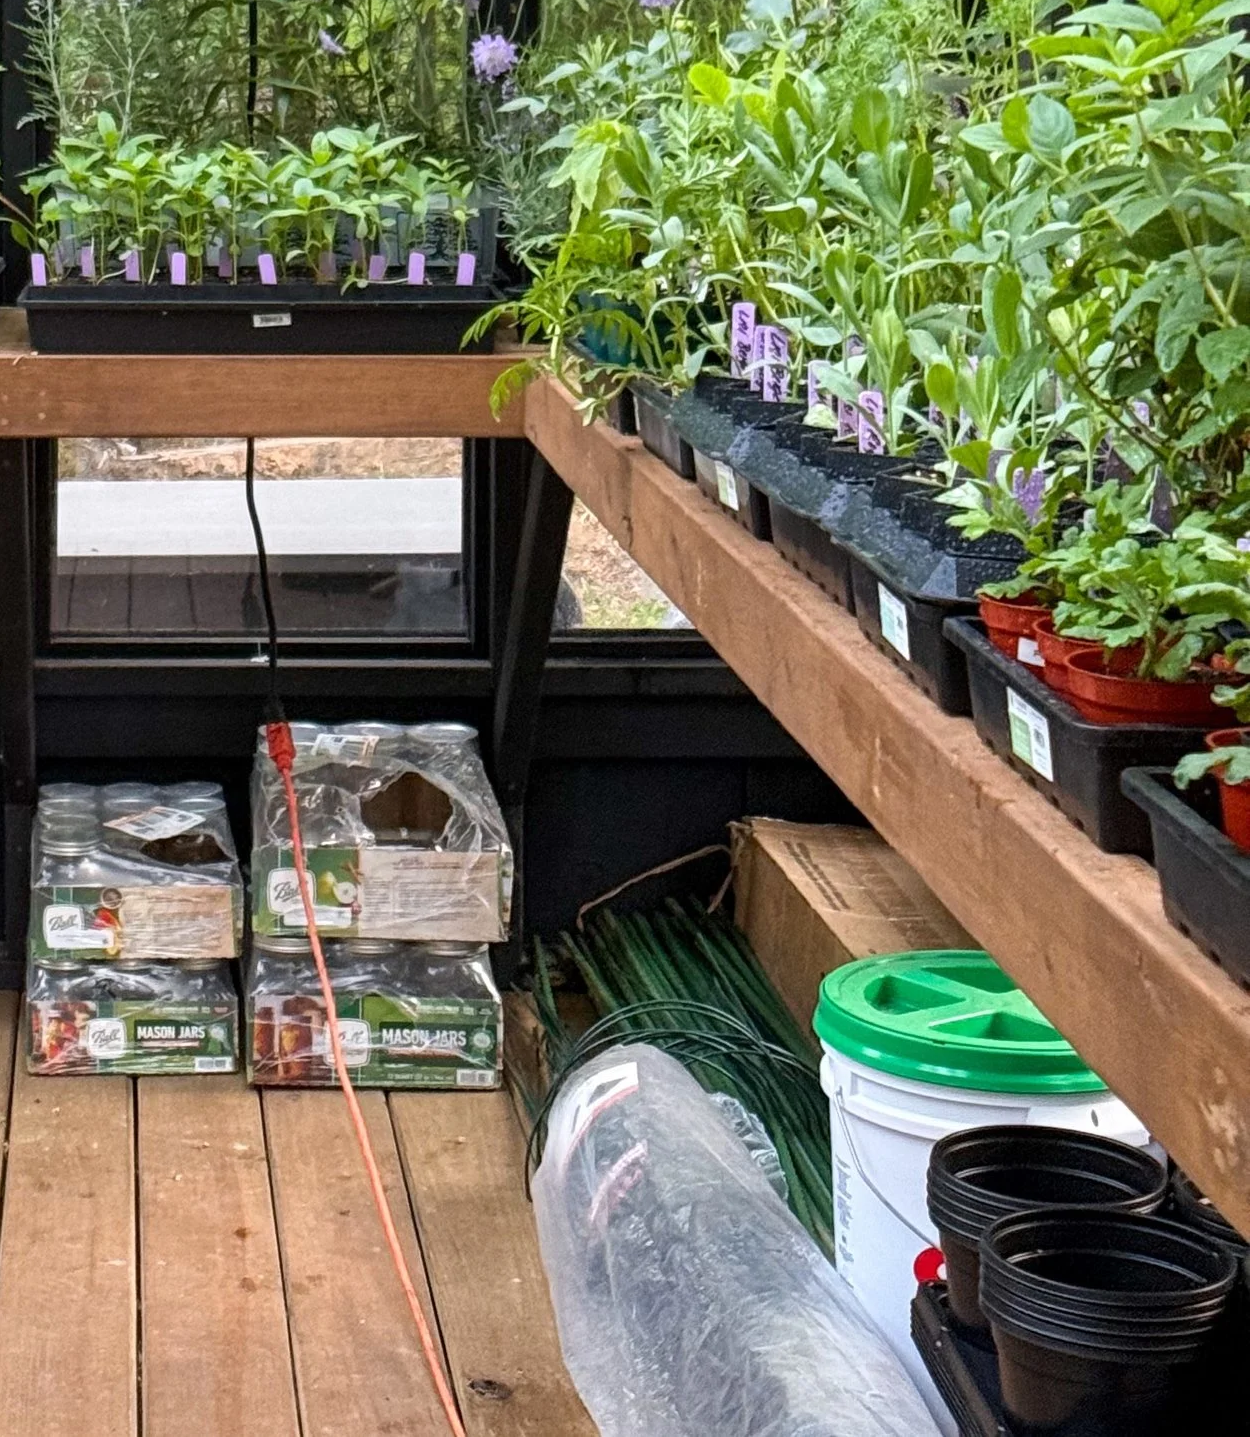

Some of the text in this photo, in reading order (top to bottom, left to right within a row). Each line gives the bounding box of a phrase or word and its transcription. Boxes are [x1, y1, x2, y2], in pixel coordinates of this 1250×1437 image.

[48, 913, 79, 932] Ball
[91, 1028, 121, 1048] Ball
[137, 1025, 207, 1040] MASON JARS
[381, 1028, 467, 1047] MASON JARS
